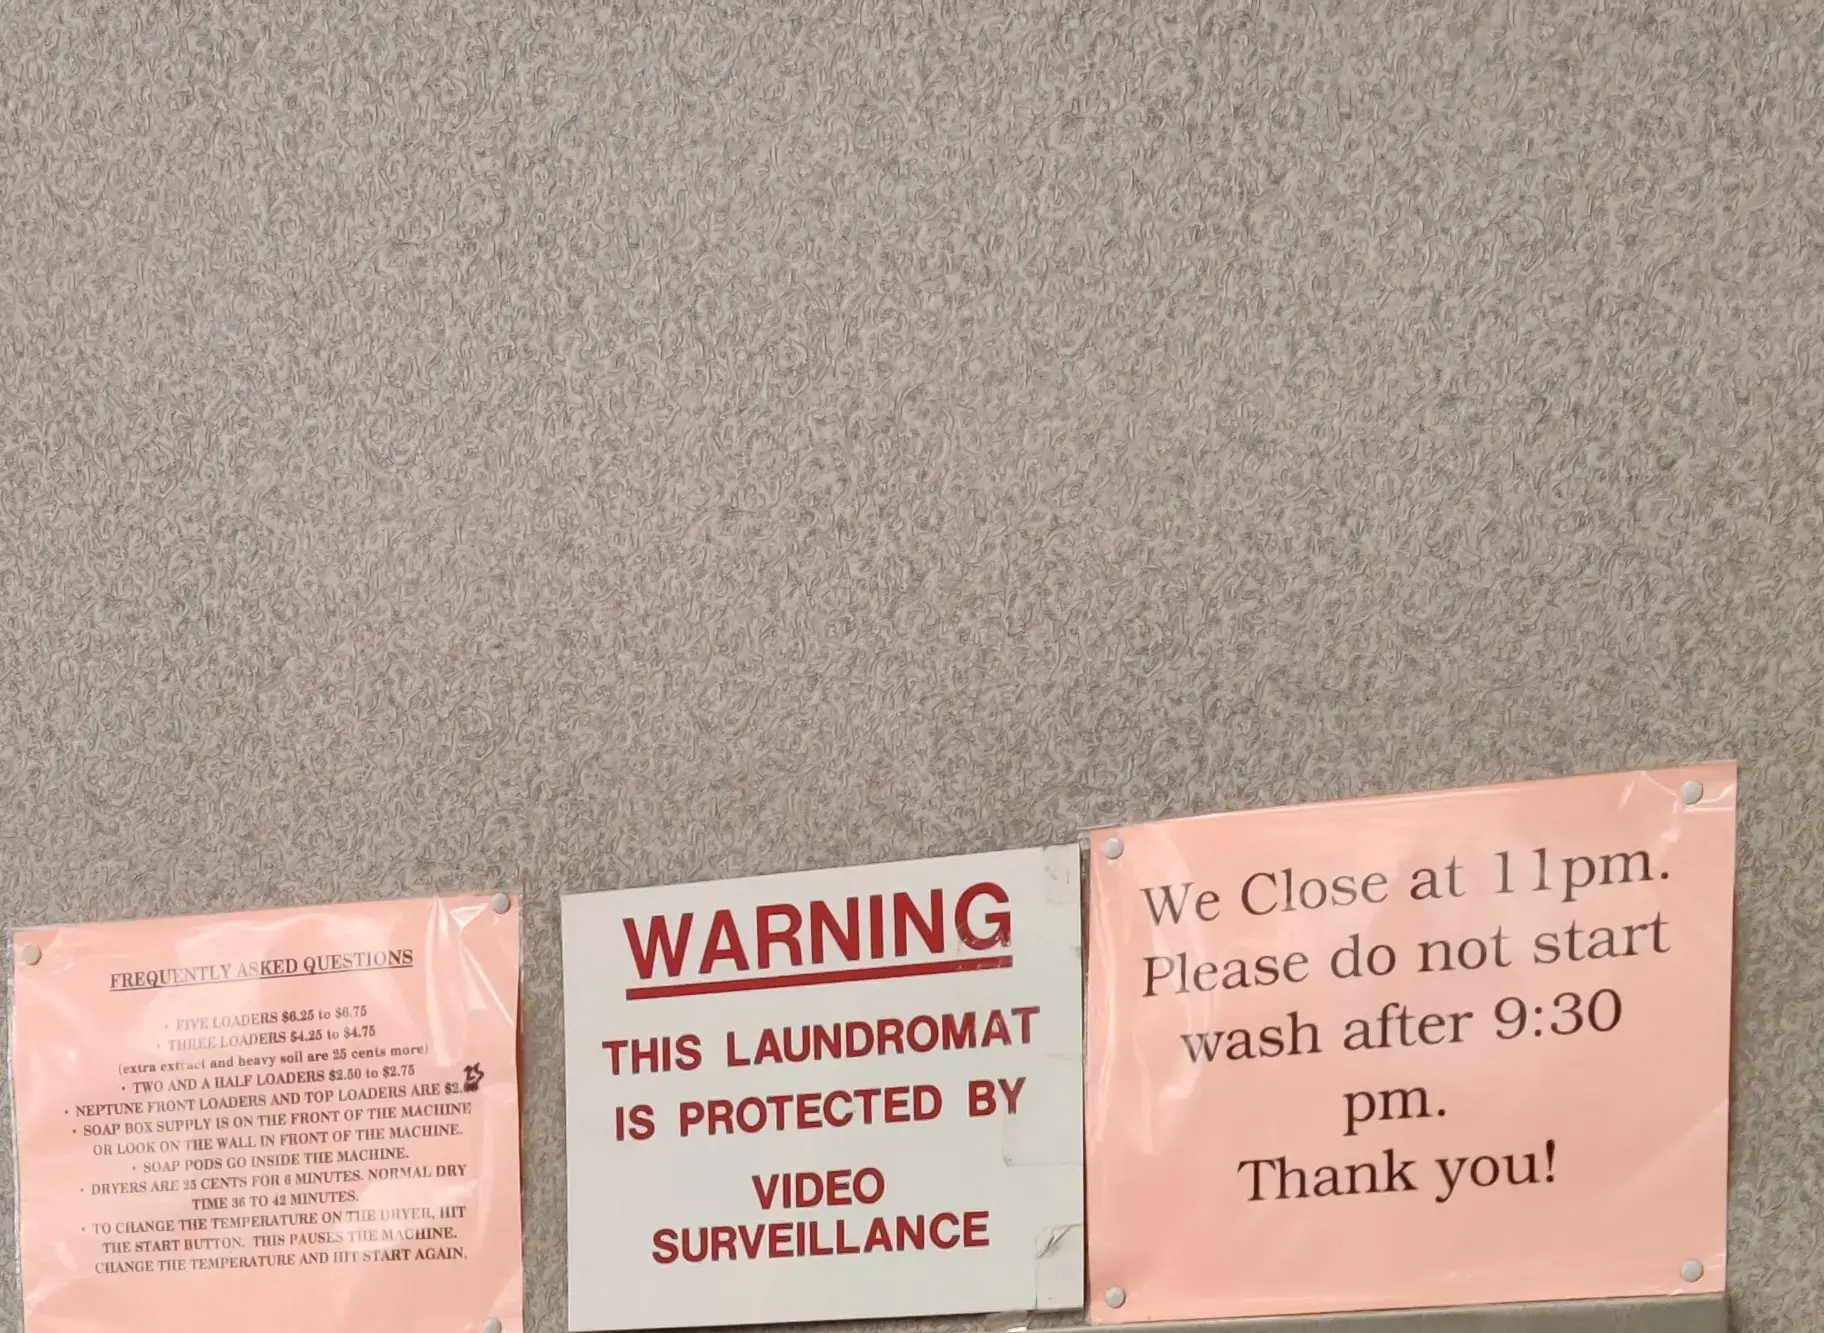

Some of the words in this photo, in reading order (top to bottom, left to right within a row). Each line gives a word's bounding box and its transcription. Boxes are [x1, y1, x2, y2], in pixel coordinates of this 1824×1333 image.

[1140, 882, 1219, 926] We
[1241, 868, 1388, 915] Close
[1410, 856, 1464, 900] at
[1496, 848, 1668, 902] 11pm.
[623, 883, 1011, 979] WARNING
[1143, 952, 1308, 997] Please
[1331, 934, 1395, 978] do
[1418, 927, 1511, 972] not
[1534, 912, 1670, 963] start
[110, 965, 229, 990] FREQUENTLY
[237, 956, 298, 978] ASKED
[304, 949, 414, 973] QUESTIONS
[602, 1034, 701, 1075] THIS
[727, 1006, 1040, 1067] LAUNDROMAT
[1180, 1011, 1321, 1062] wash
[1344, 1003, 1473, 1050] after
[1495, 989, 1621, 1039] 9:30
[132, 1081, 163, 1093] TWO
[168, 1079, 197, 1091] AND
[201, 1078, 210, 1089] A
[215, 1075, 252, 1088] HALF
[257, 1070, 324, 1086] LOADERS
[366, 1069, 378, 1079] to
[383, 1064, 414, 1078] $2.75
[616, 1105, 655, 1141] IS
[680, 1085, 942, 1137] PROTECTED
[969, 1077, 1026, 1117] BY
[1344, 1088, 1445, 1136] pm.
[144, 1161, 179, 1173] SOAP
[186, 1158, 222, 1170] PODS
[227, 1157, 246, 1168] GO
[252, 1154, 299, 1167] INSIDE
[304, 1152, 332, 1164] THE
[337, 1147, 409, 1162] MACHINE.
[752, 1168, 884, 1209] VIDEO
[1238, 1149, 1417, 1201] Thank
[1435, 1140, 1555, 1203] you!
[192, 1197, 227, 1210] TIME
[232, 1197, 245, 1208] 36
[250, 1195, 268, 1207] TO
[273, 1195, 286, 1206] 42
[291, 1190, 358, 1205] MINUTES.
[653, 1211, 989, 1264] SURVEILLANCE
